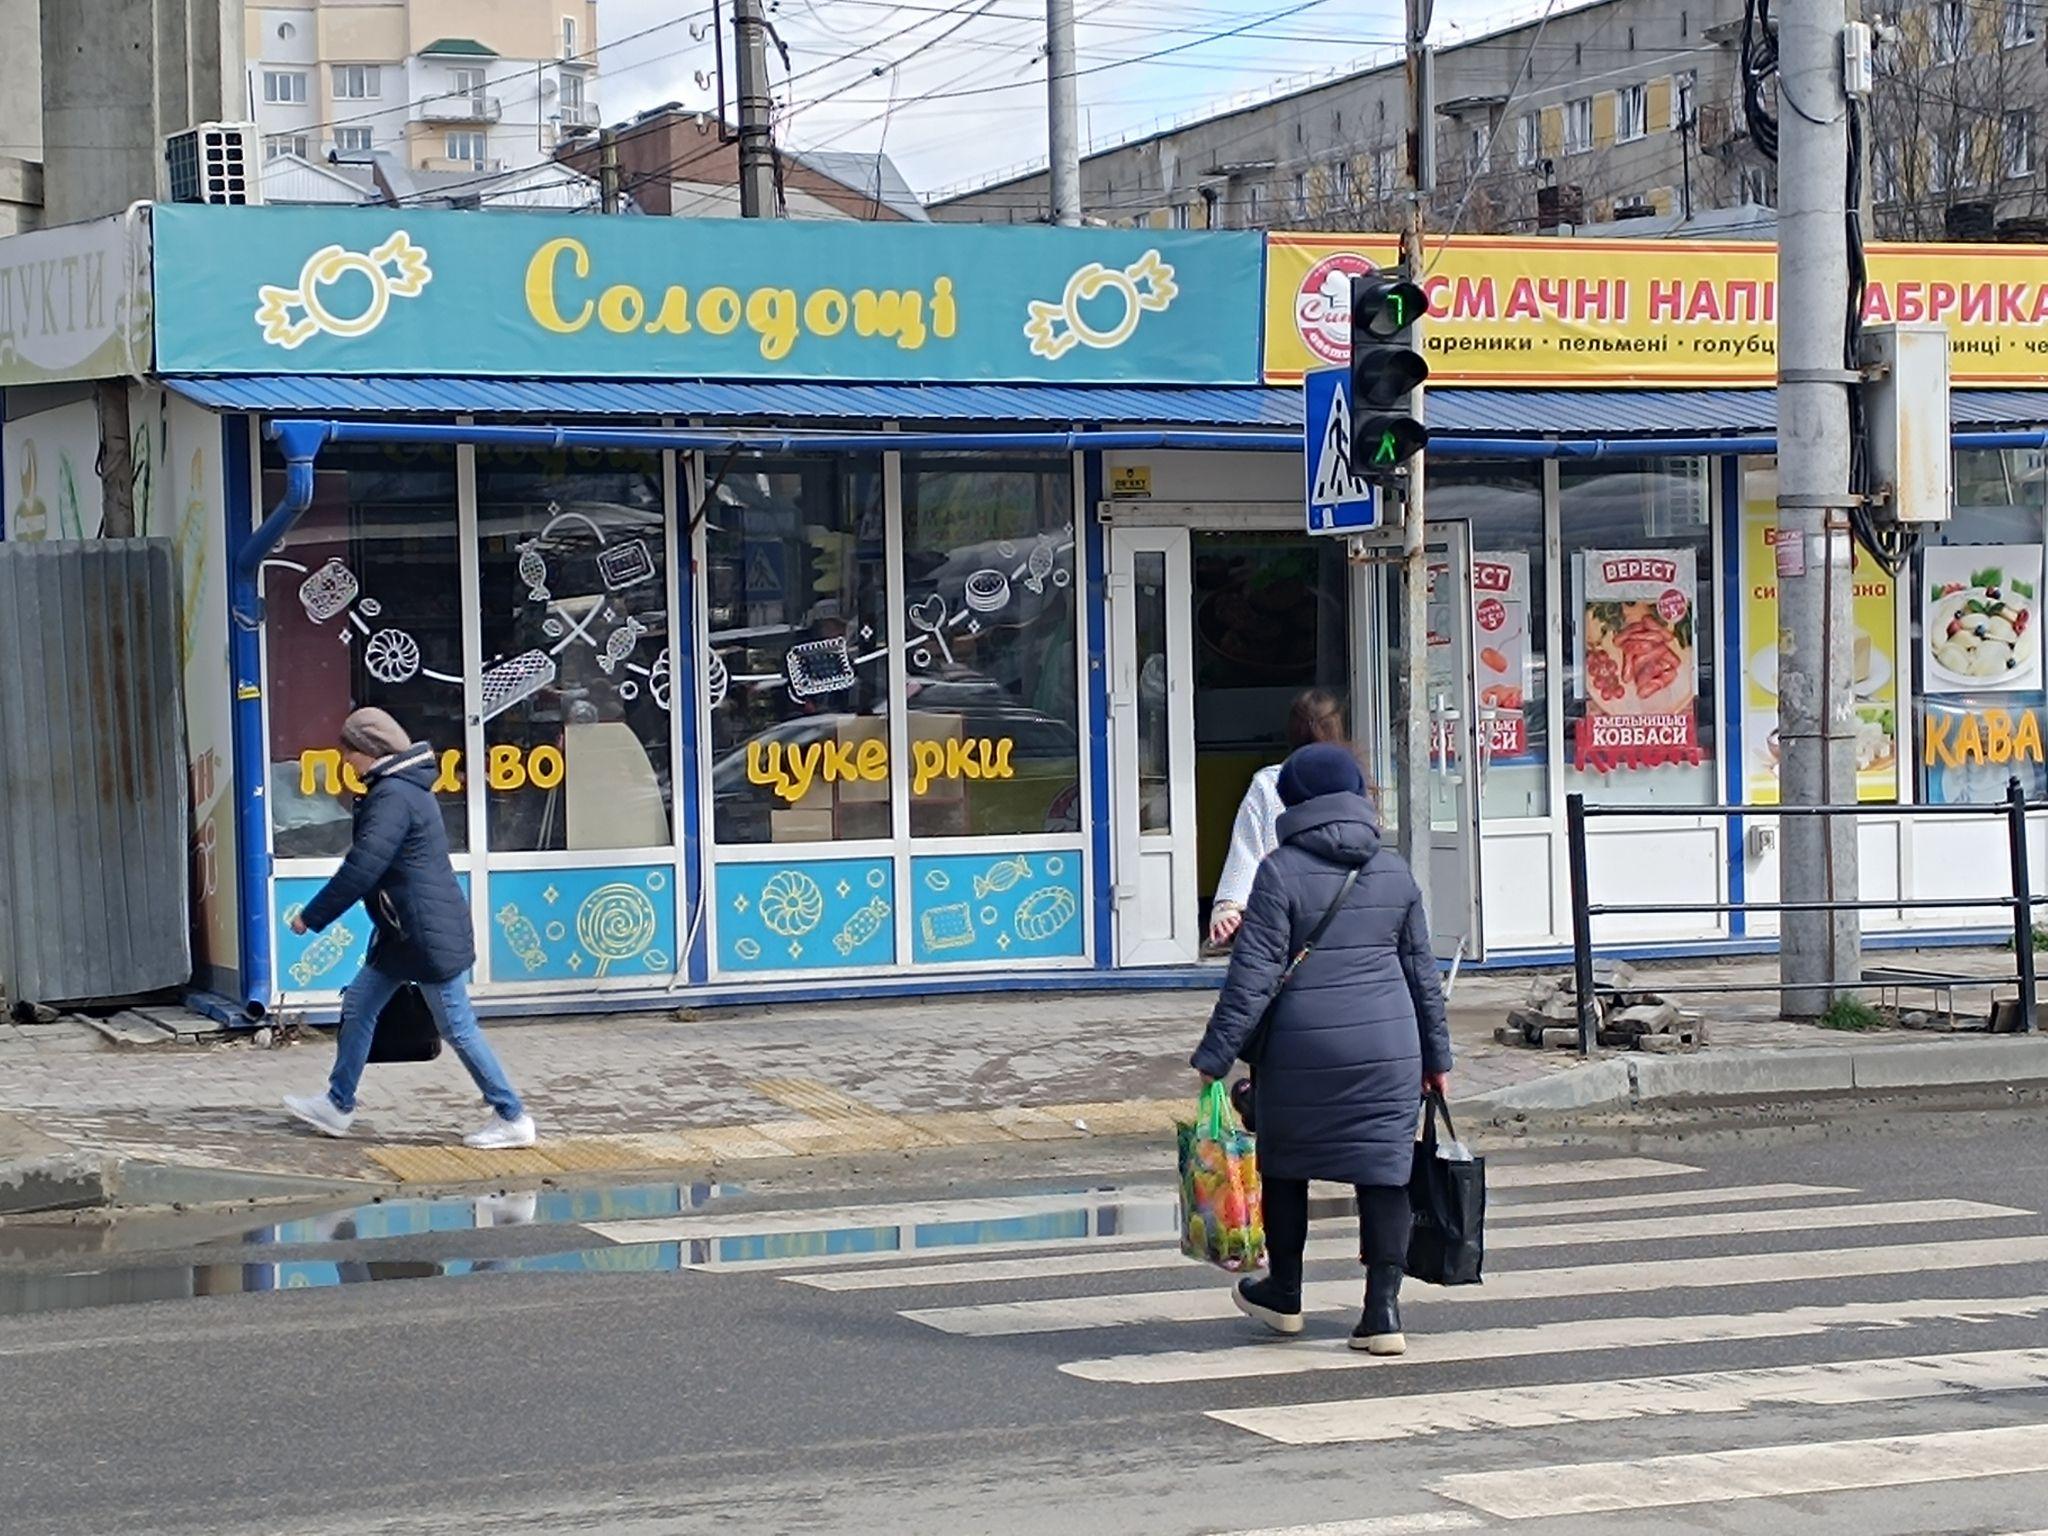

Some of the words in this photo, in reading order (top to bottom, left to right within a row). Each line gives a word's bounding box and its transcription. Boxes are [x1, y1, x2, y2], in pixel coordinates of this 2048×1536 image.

[525, 237, 957, 360] Солодощі
[1387, 294, 1402, 325] 7
[1424, 275, 1626, 320] СМАЧНІ
[1558, 334, 1668, 353] пельмені
[1693, 335, 1776, 357] голубц
[1948, 336, 2001, 356] инці
[1605, 561, 1674, 580] ВЕРЕСТ
[1592, 727, 1689, 746] КОВБАСИ
[1925, 708, 2044, 768] КАВА
